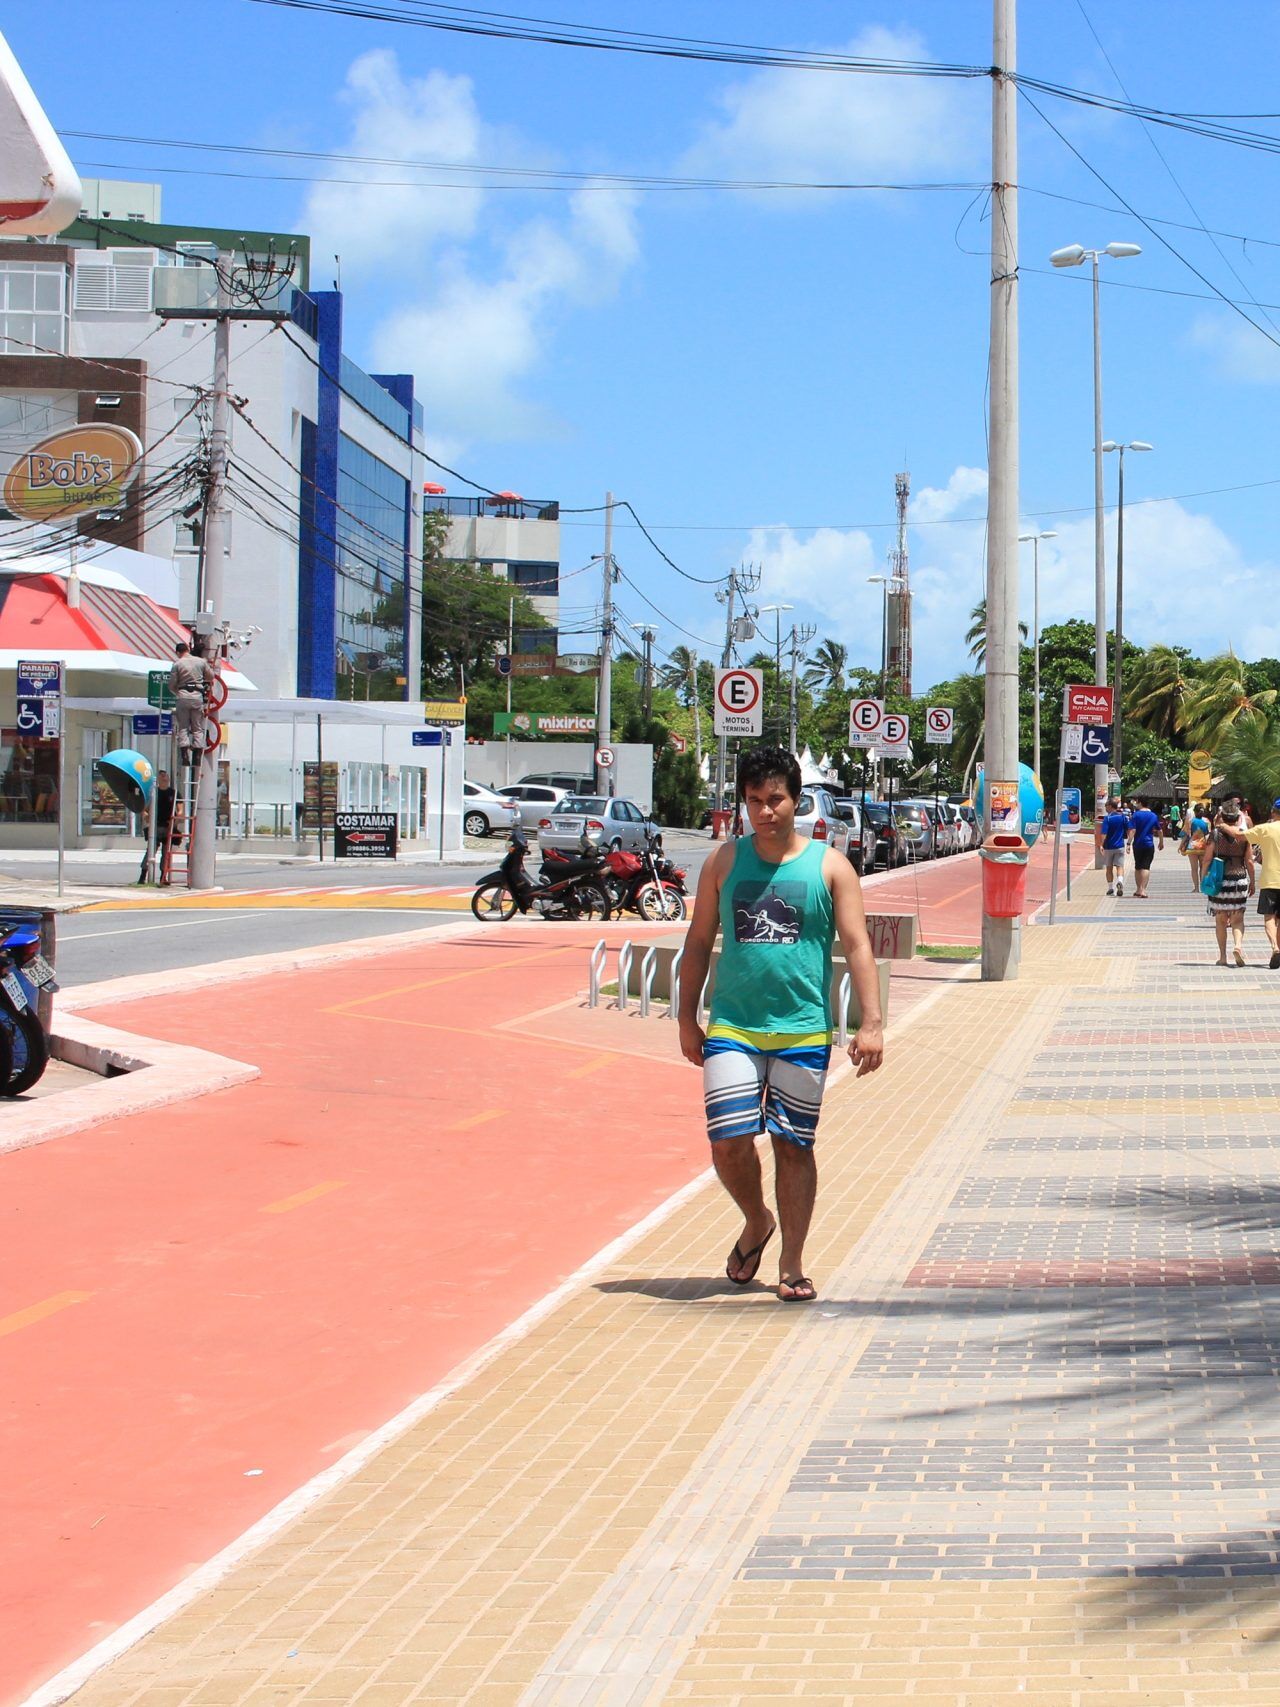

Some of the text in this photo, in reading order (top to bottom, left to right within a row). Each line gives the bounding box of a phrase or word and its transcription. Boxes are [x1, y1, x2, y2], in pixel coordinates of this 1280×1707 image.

[29, 453, 112, 489] Bob's
[63, 488, 114, 505] burgers
[1072, 694, 1109, 706] CNA
[538, 715, 596, 729] mixirica
[336, 815, 395, 826] COSTAMAR
